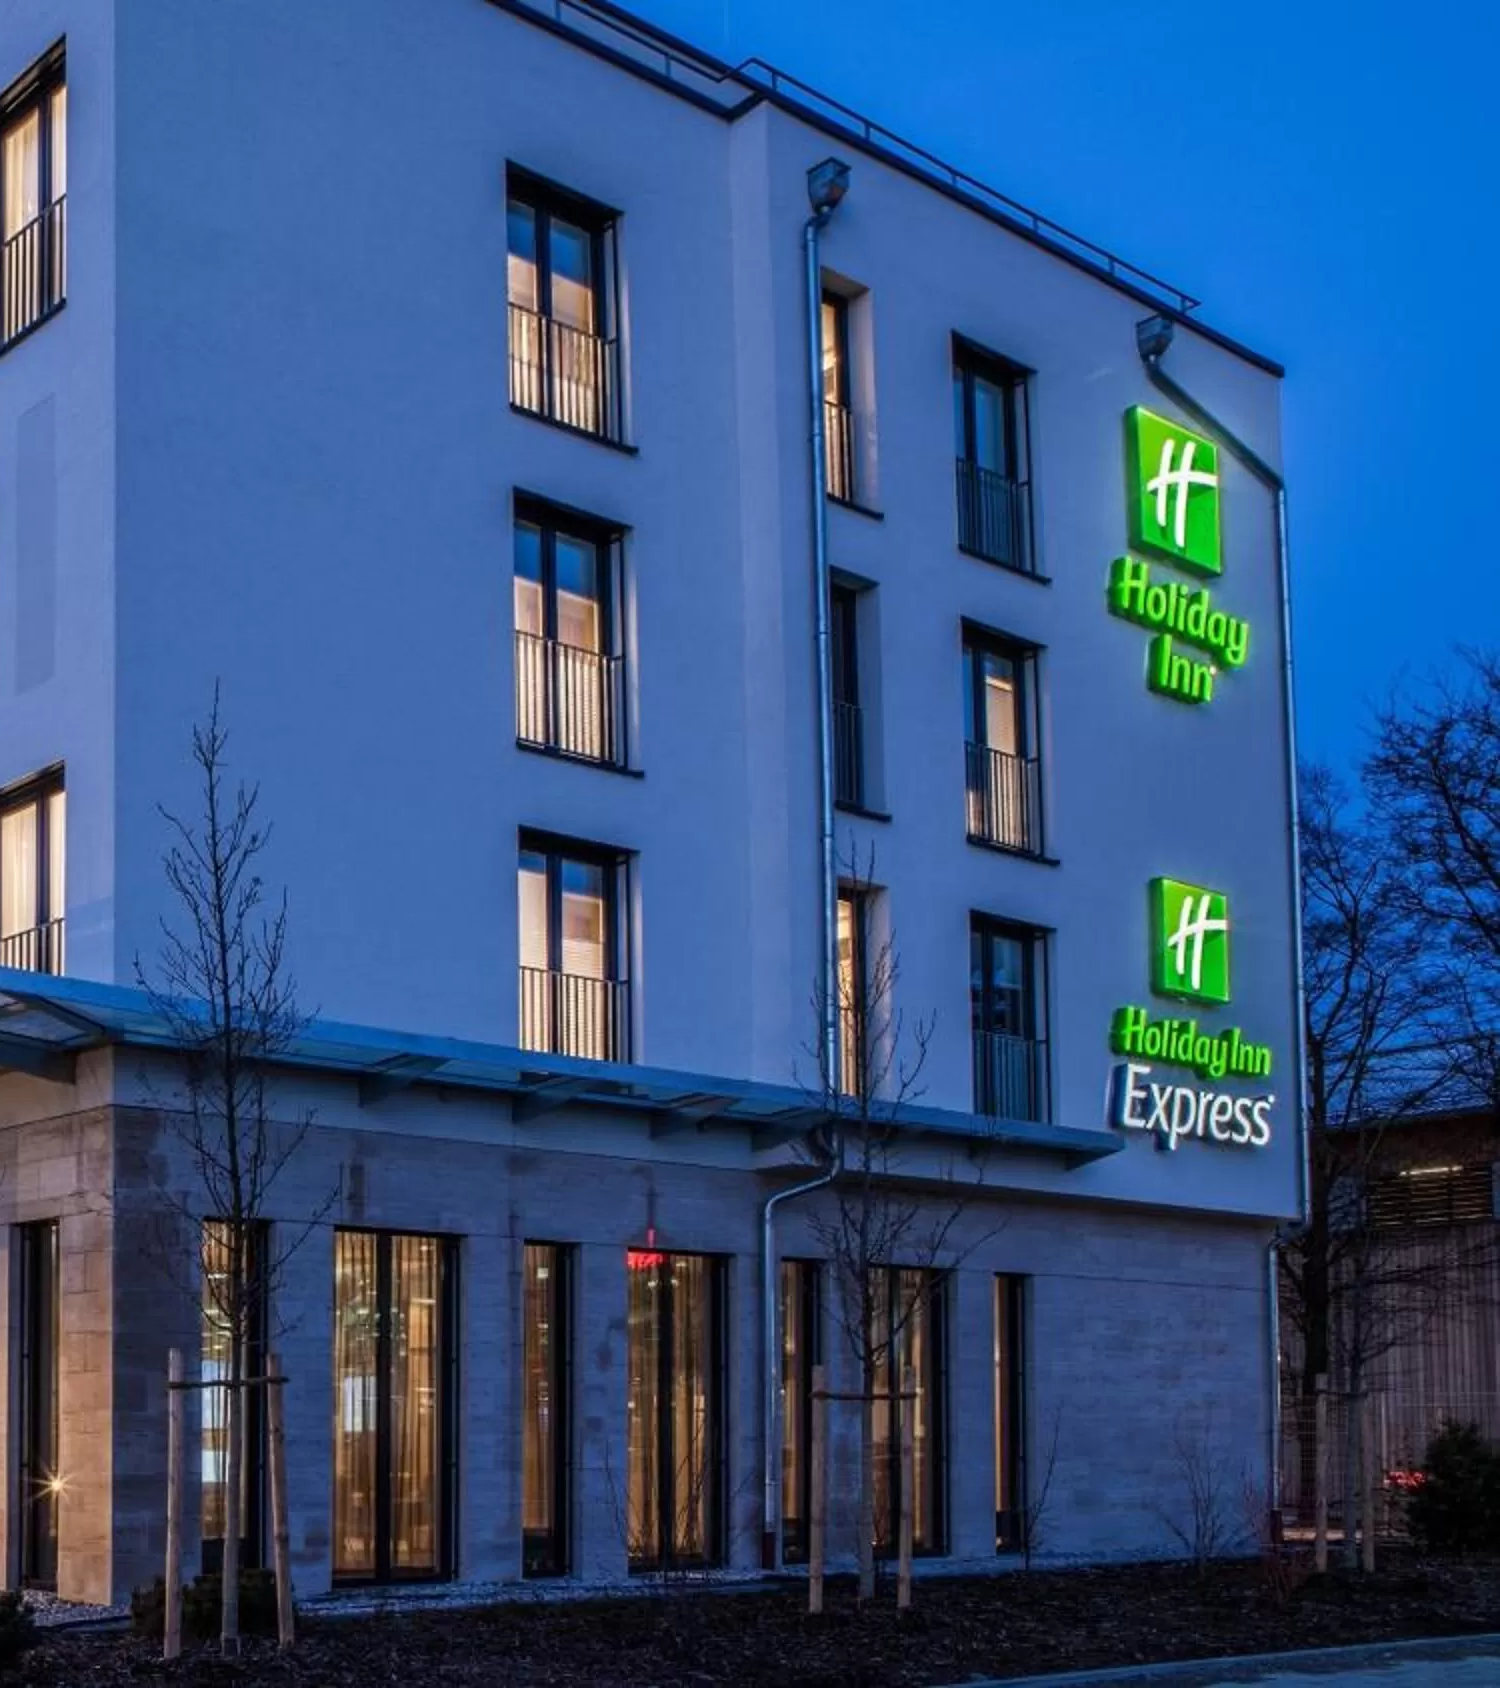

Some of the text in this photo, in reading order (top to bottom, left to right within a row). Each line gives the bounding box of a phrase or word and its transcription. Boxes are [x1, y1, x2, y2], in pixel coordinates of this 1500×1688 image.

[1117, 556, 1249, 667] Holiday
[1157, 633, 1212, 703] Inn
[1119, 1005, 1272, 1079] Holiday Inn
[1121, 1062, 1273, 1151] Express
